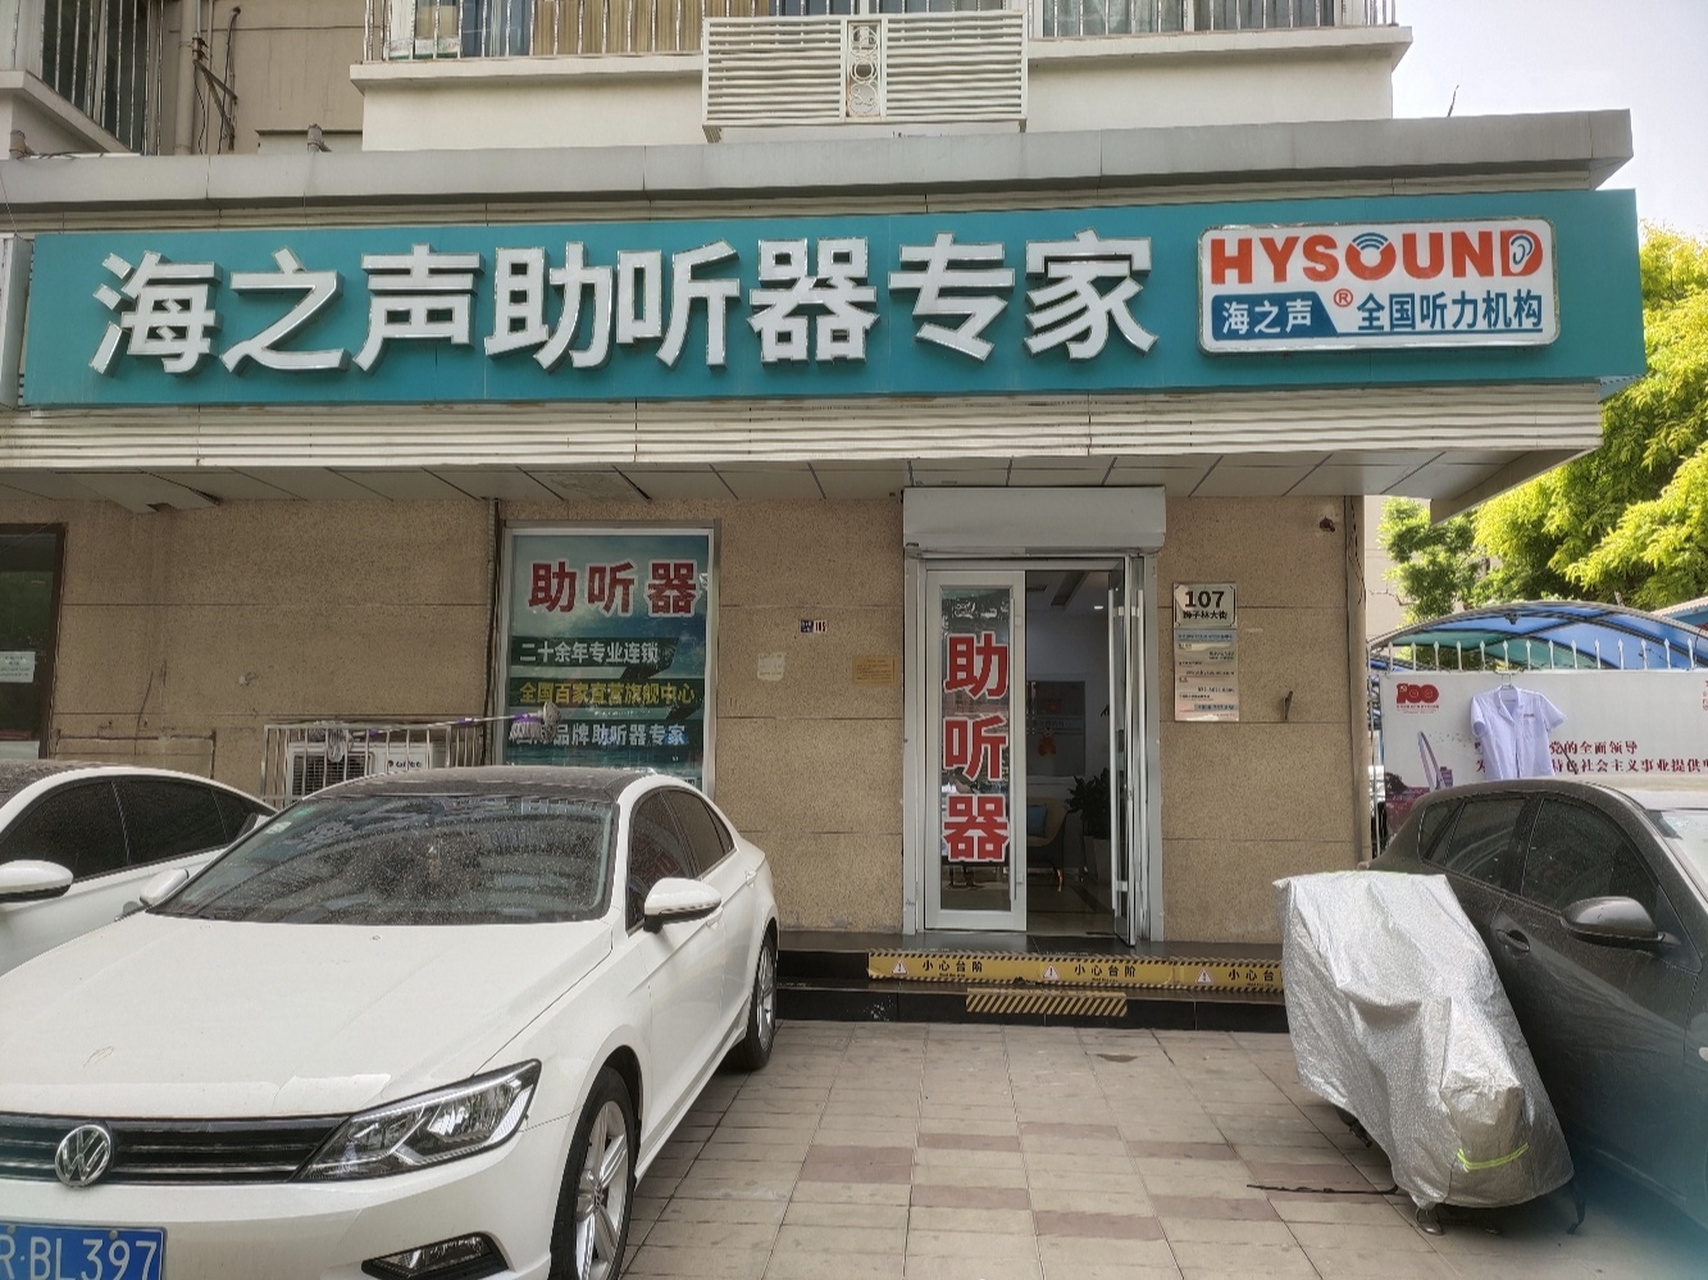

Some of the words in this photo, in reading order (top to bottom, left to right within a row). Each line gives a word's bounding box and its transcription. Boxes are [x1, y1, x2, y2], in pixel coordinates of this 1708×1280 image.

[1210, 229, 1544, 285] HYSOUND
[90, 227, 1159, 376] 海之声助听器专家
[1222, 298, 1313, 335] 海之声
[1356, 289, 1543, 331] 全国听力机构
[528, 561, 697, 614] 助听器
[1184, 590, 1225, 609] 107
[519, 641, 660, 664] 二十余年专业连锁
[520, 681, 695, 705] 全国百家直营旗舰中心
[516, 723, 686, 746] 品牌助听器专家
[943, 631, 1010, 863] 助听器
[922, 960, 983, 973] 小心台阶
[1074, 964, 1136, 977] 小心台阶
[1228, 969, 1284, 982] 小心台
